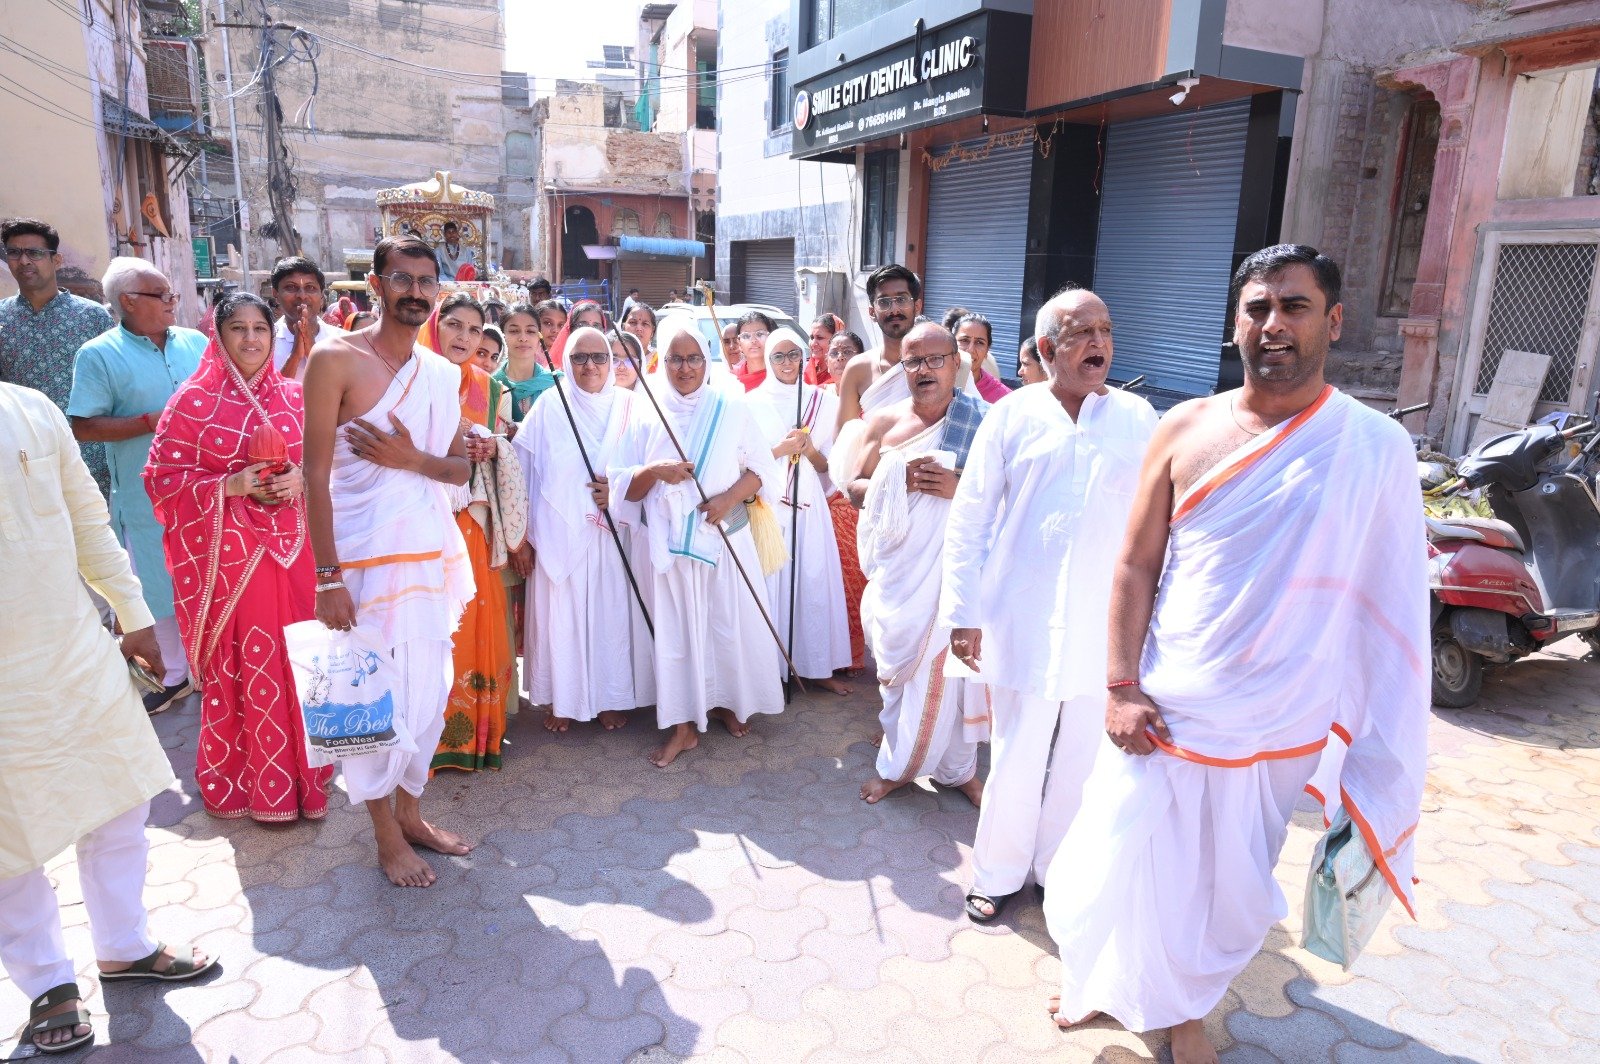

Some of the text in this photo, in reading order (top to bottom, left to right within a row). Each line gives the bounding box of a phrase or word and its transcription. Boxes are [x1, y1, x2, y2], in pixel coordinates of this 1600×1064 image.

[811, 35, 974, 115] SMILE CITY DENTAL CLINIC
[307, 706, 392, 736] The Best
[325, 736, 376, 747] Foot Wear
